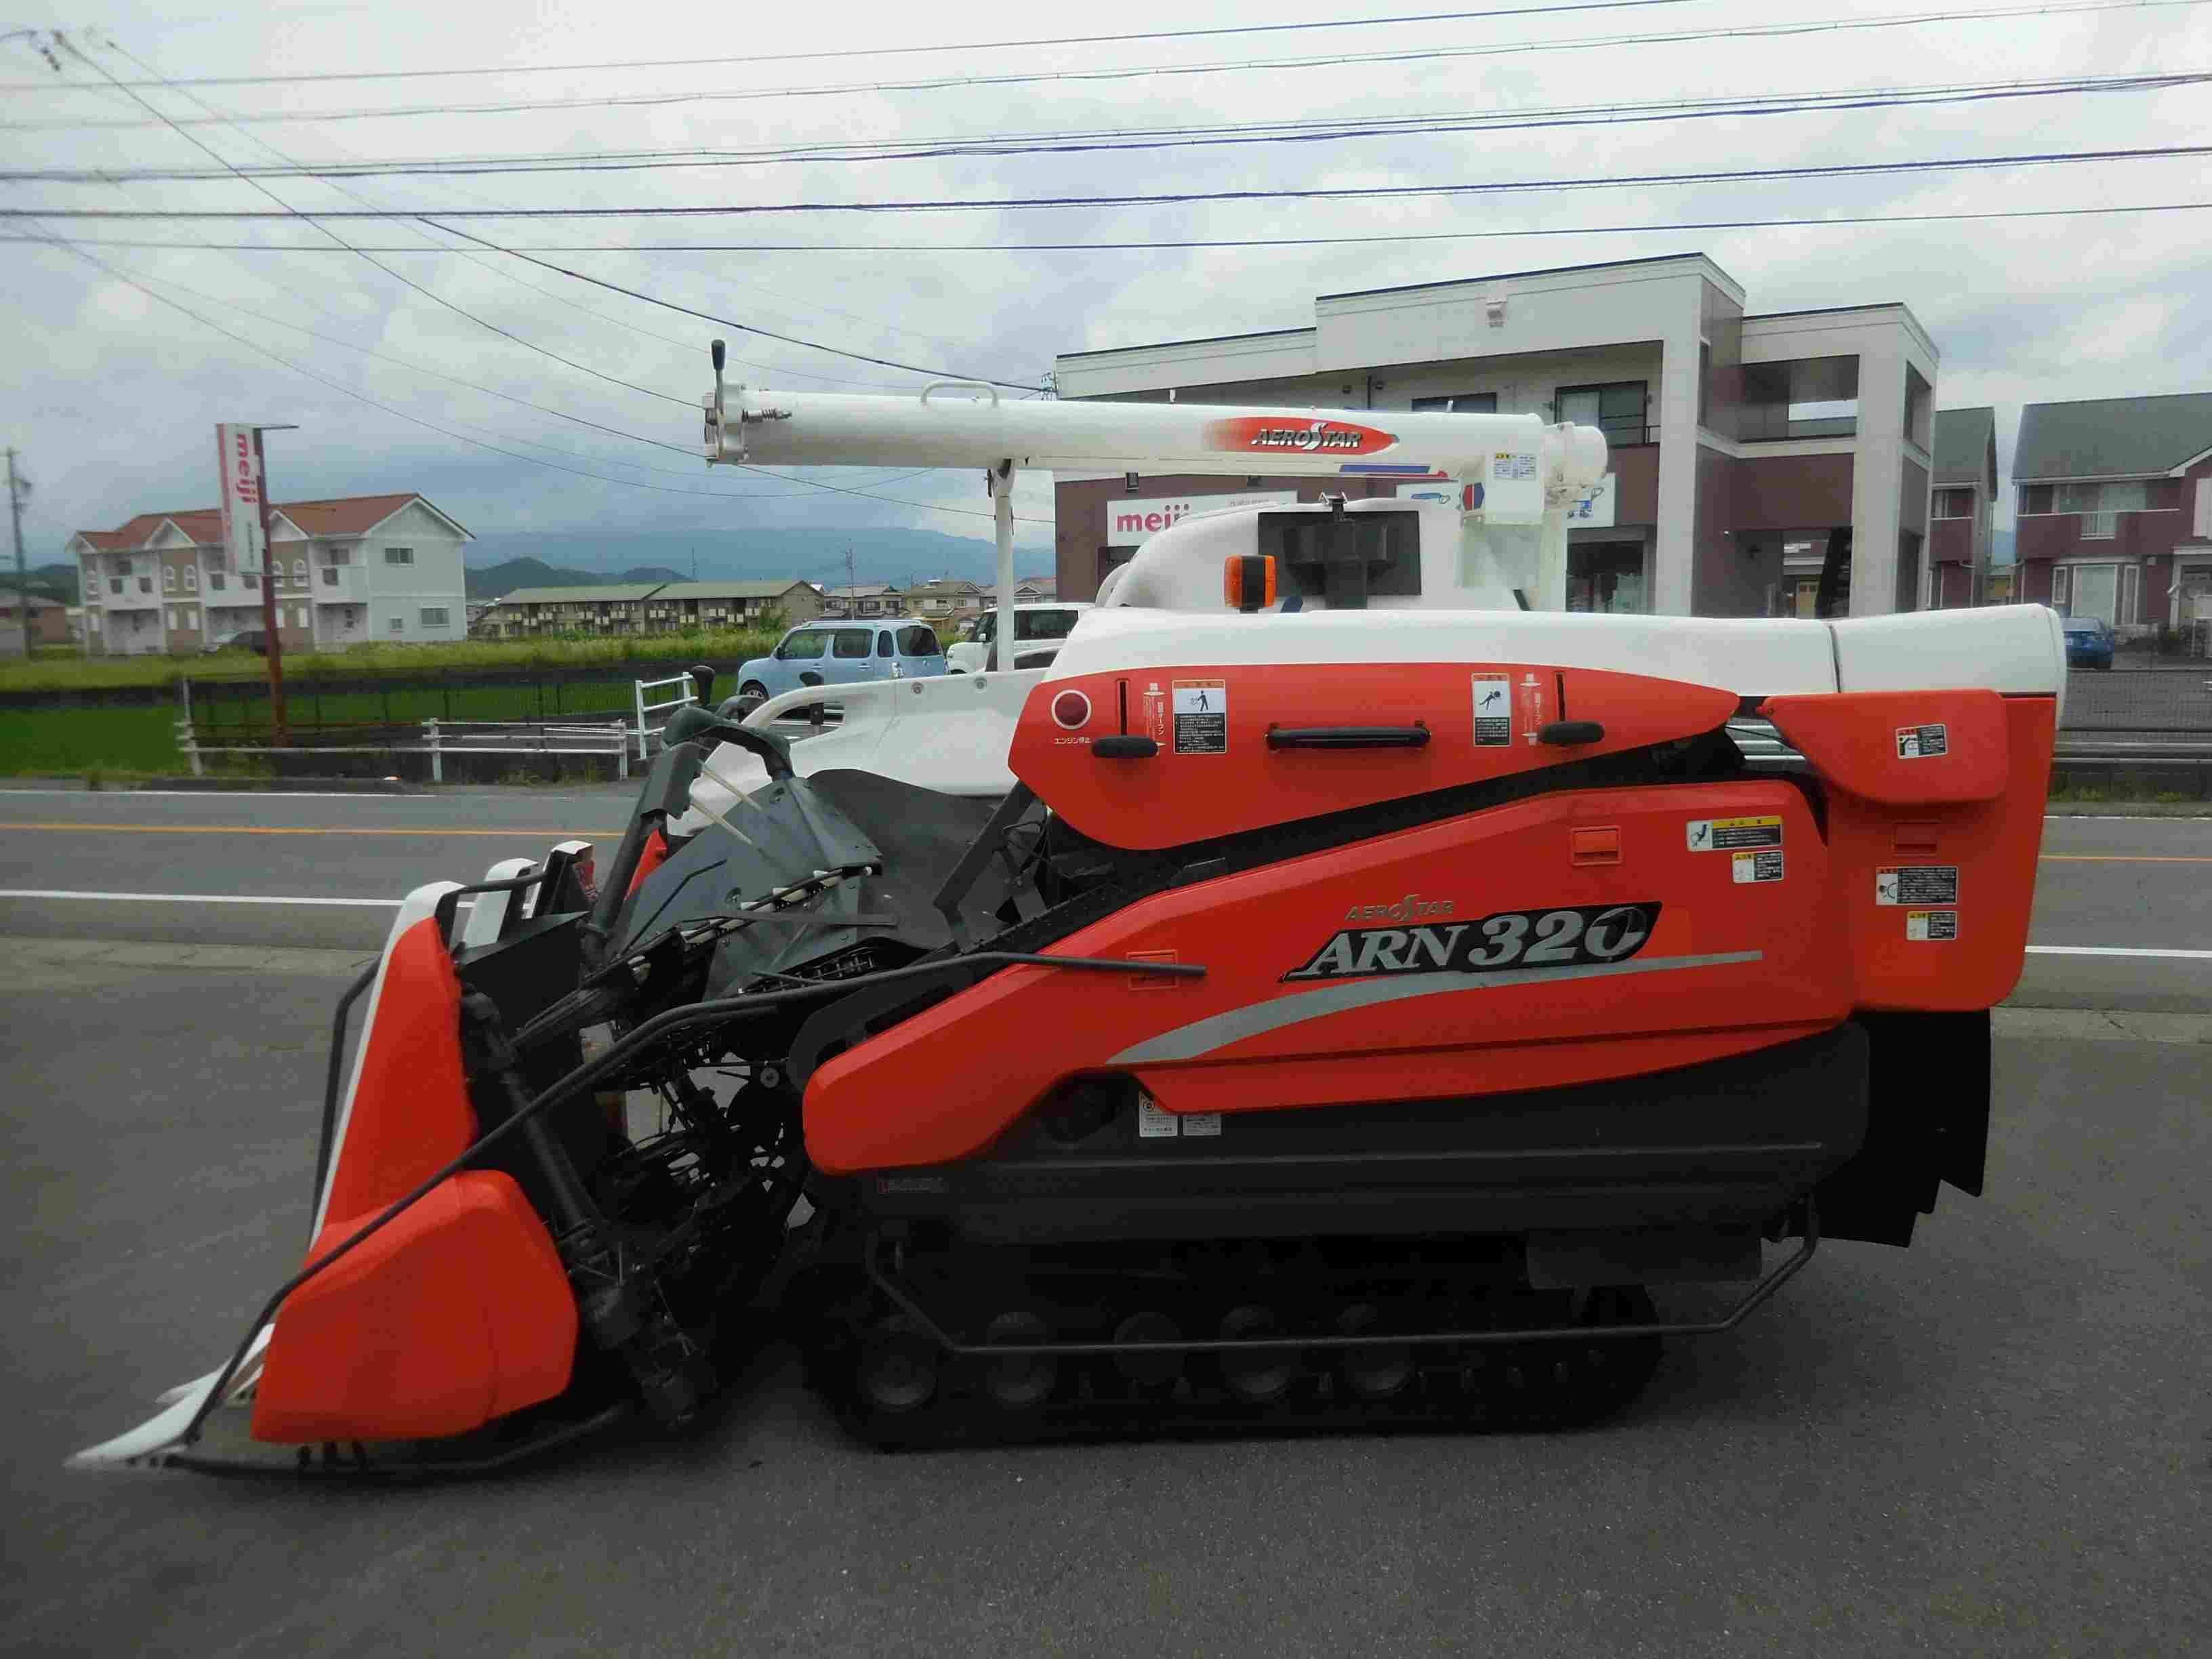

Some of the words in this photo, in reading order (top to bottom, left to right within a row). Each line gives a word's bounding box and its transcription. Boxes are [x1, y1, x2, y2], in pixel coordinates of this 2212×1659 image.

[237, 432, 260, 504] meiji
[1288, 924, 1469, 977] ARN
[1468, 906, 1648, 967] 320
